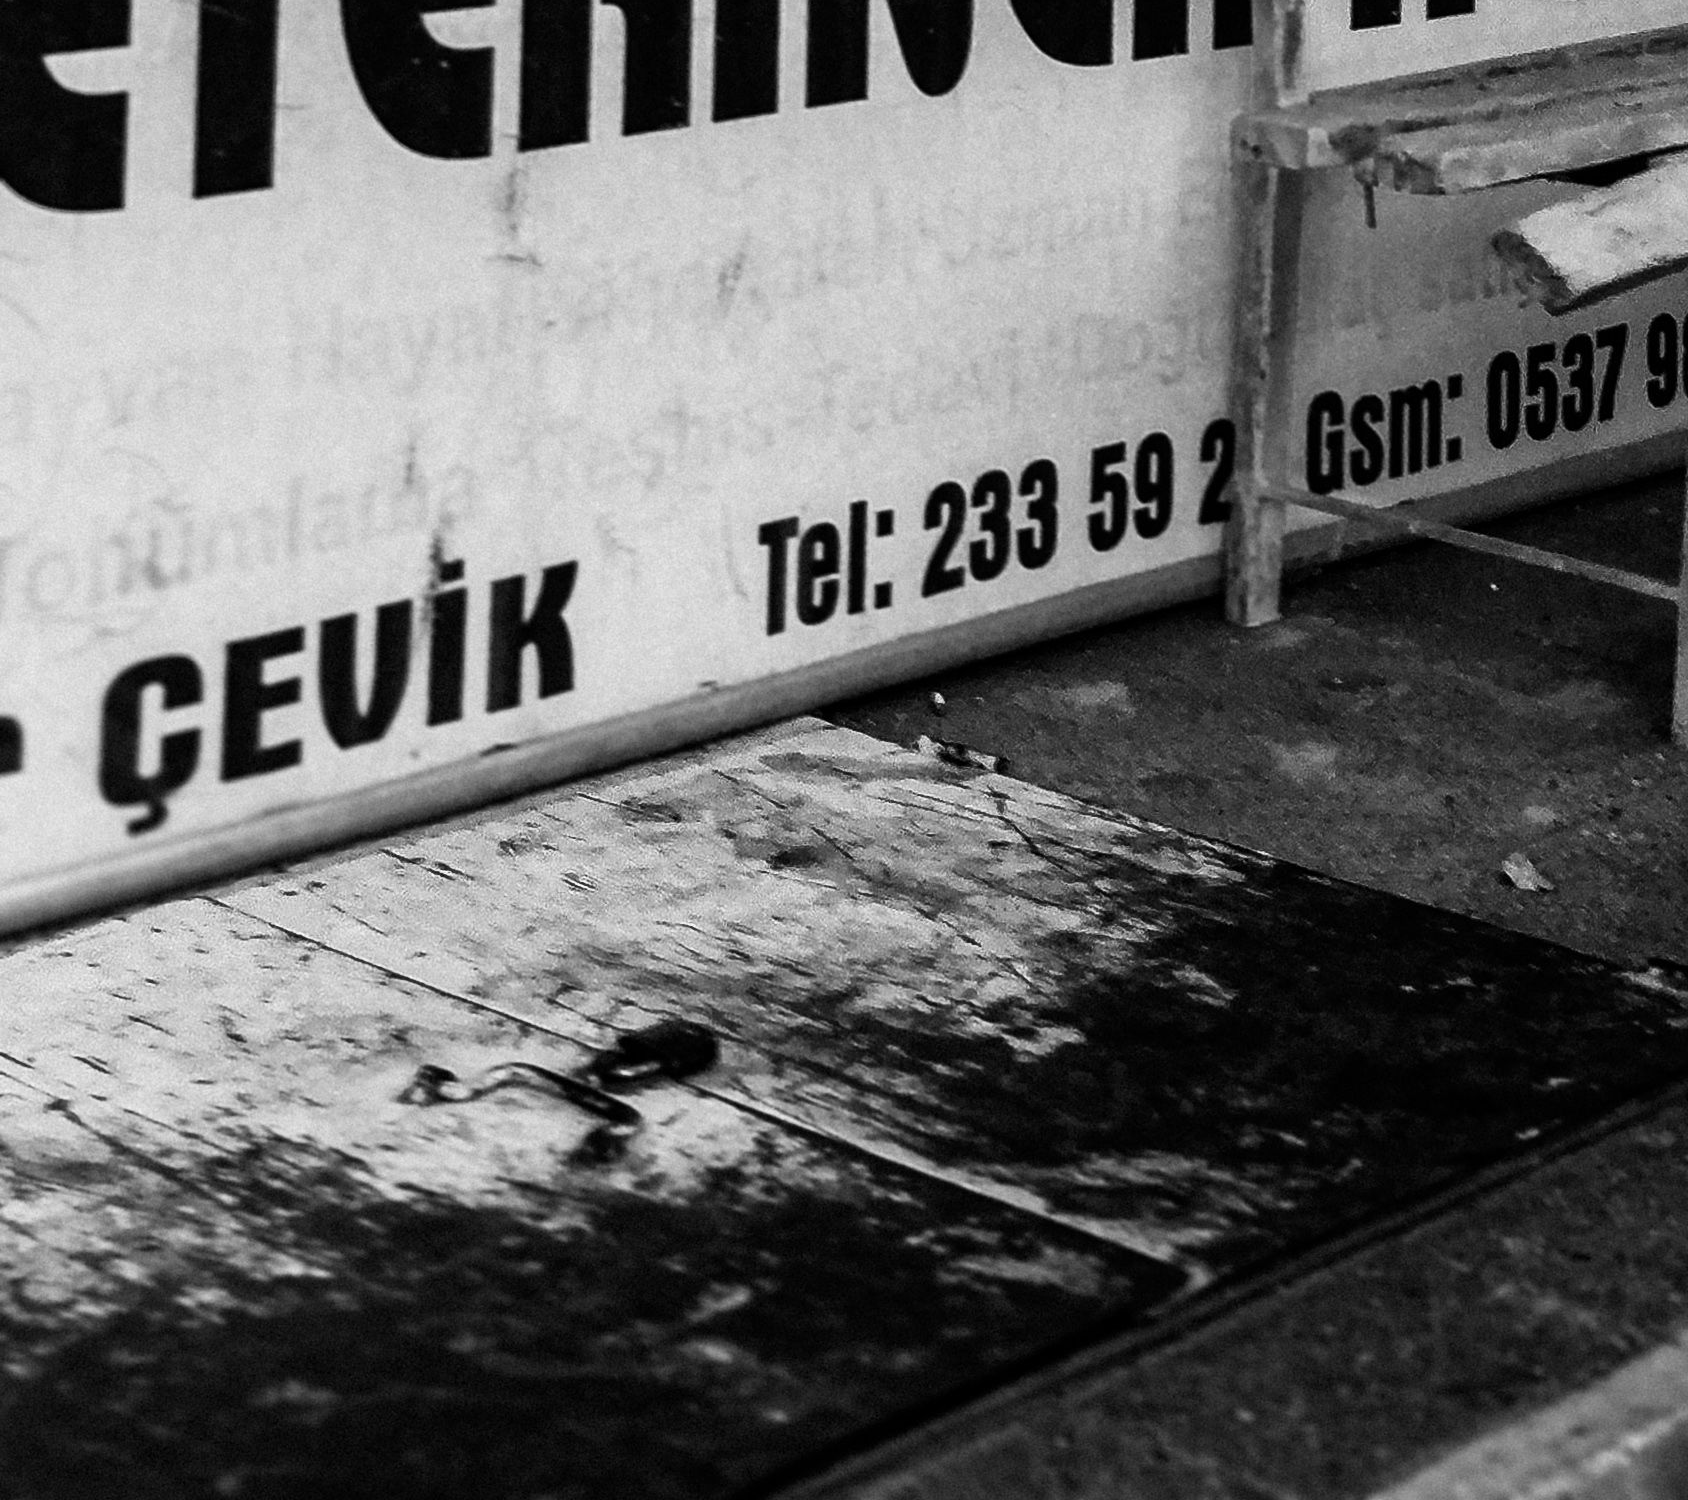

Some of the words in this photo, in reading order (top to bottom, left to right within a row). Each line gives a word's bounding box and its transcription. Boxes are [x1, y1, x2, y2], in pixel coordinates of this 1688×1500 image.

[1304, 370, 1465, 494] Gsm:
[1485, 314, 1627, 449] 0537
[757, 498, 896, 637] Tel:
[919, 456, 1061, 598] 233
[1086, 430, 1175, 554] 59
[1201, 417, 1237, 524] 2
[98, 556, 580, 837] ÇEVİK
